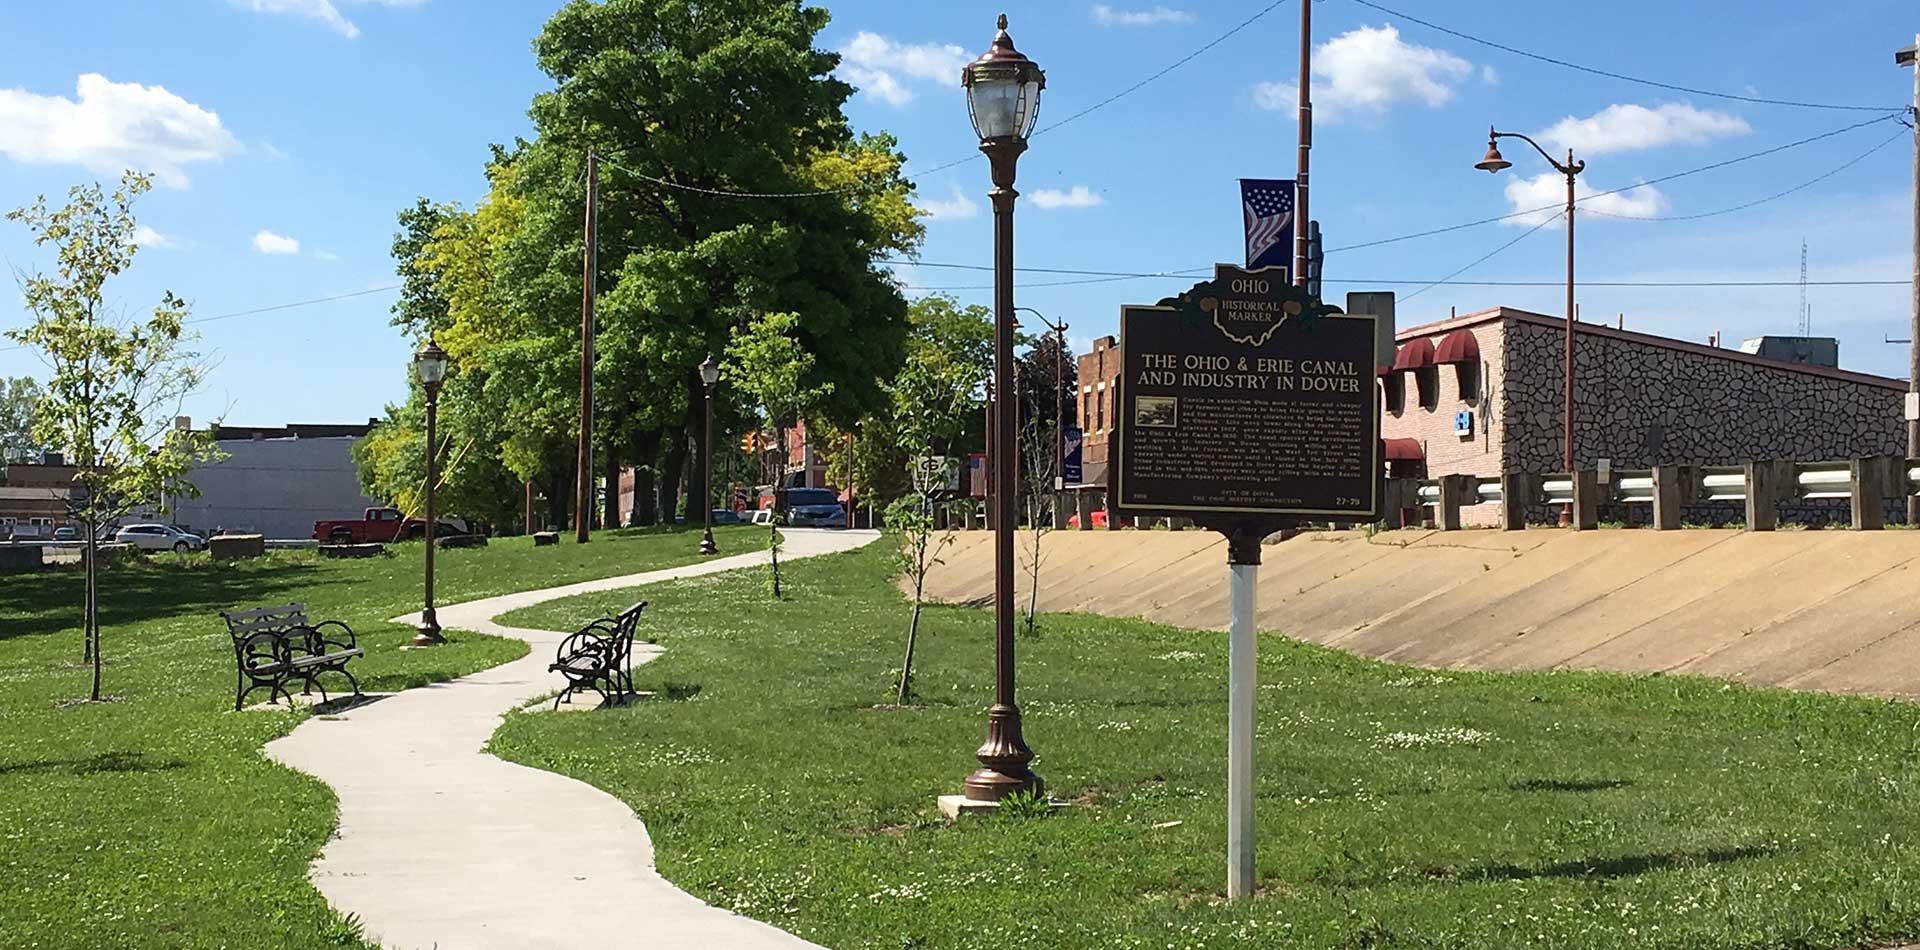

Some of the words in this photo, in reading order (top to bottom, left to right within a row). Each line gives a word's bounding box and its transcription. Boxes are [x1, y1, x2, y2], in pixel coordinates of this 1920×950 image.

[1231, 279, 1269, 294] OHIO
[1221, 300, 1280, 312] HISTORICAL
[1228, 311, 1273, 323] MARKER
[1141, 353, 1177, 369] THE
[1184, 355, 1230, 371] OHIO
[1237, 357, 1248, 371] &
[1257, 358, 1294, 374] ERIE
[1300, 360, 1358, 376] CANAL
[1137, 371, 1176, 386] AND
[1182, 373, 1270, 390] INDUSTRY
[1277, 376, 1294, 390] IN
[1301, 377, 1361, 393] DOVER
